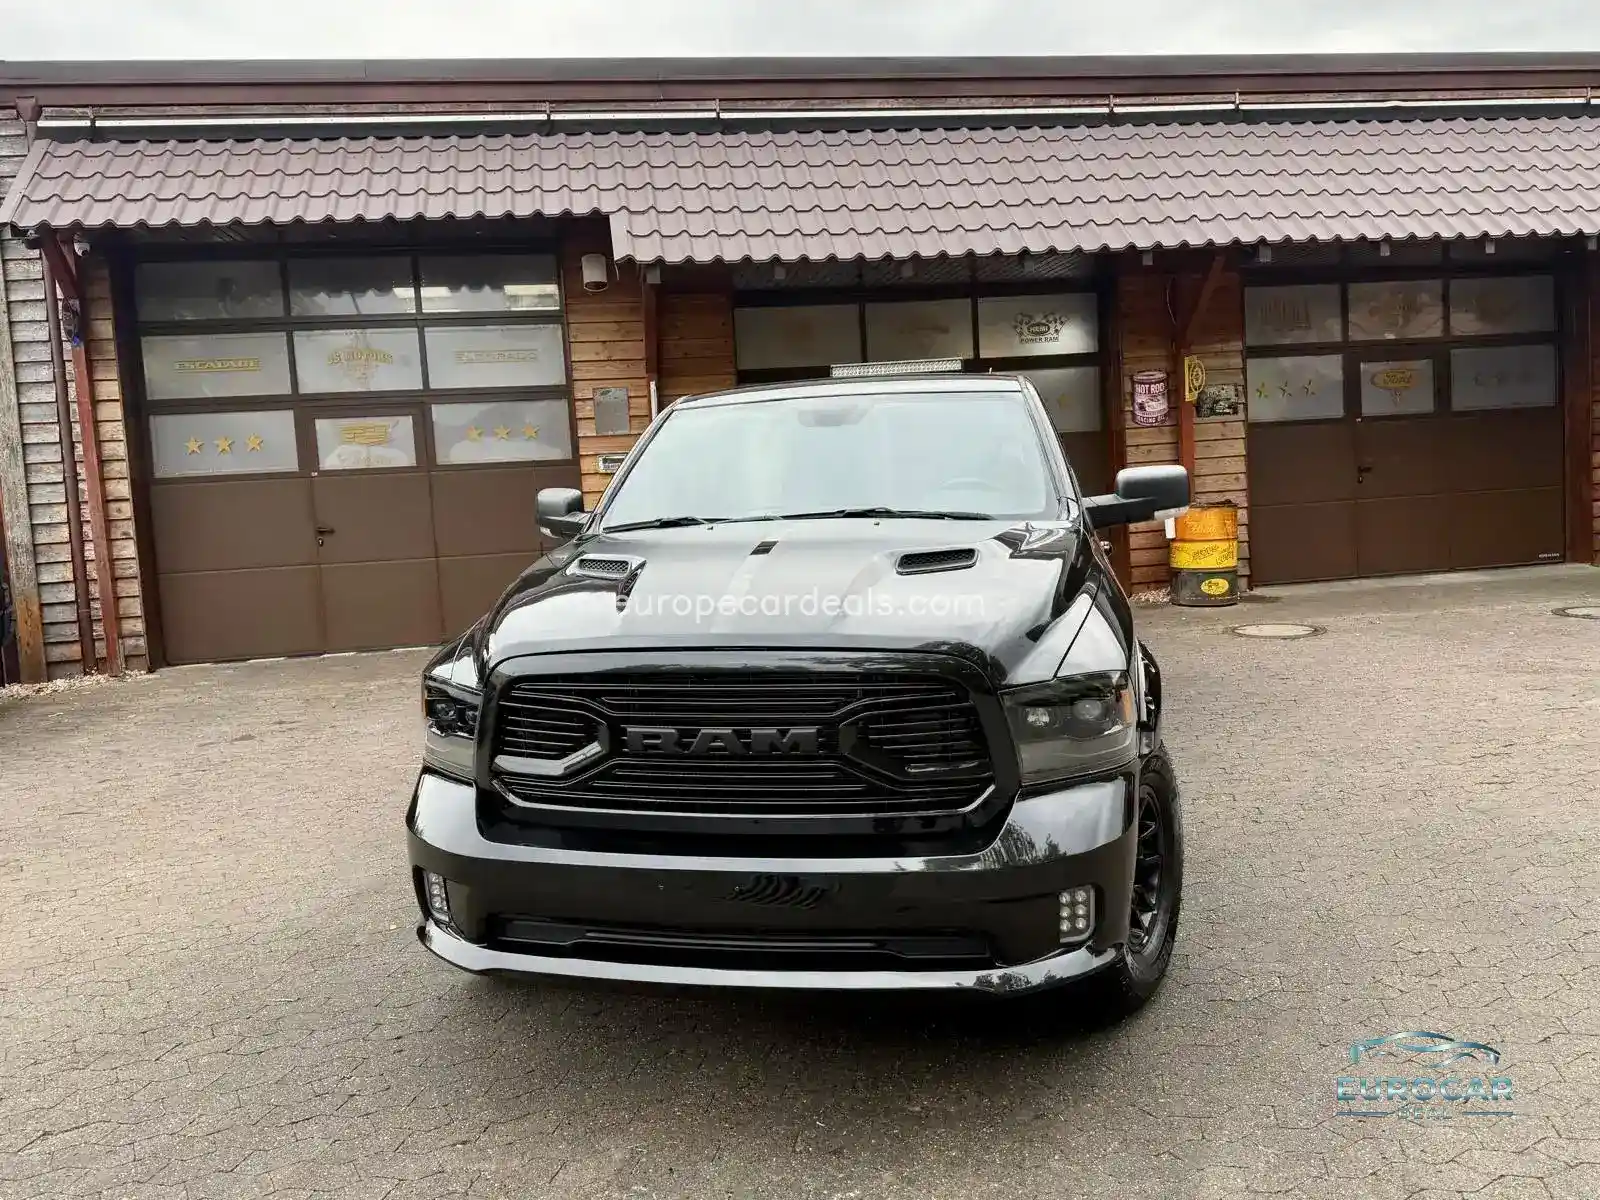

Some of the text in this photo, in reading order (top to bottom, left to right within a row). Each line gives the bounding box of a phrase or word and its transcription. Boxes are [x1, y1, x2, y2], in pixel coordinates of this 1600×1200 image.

[1135, 382, 1166, 394] HOT ROD
[626, 727, 818, 754] RAM
